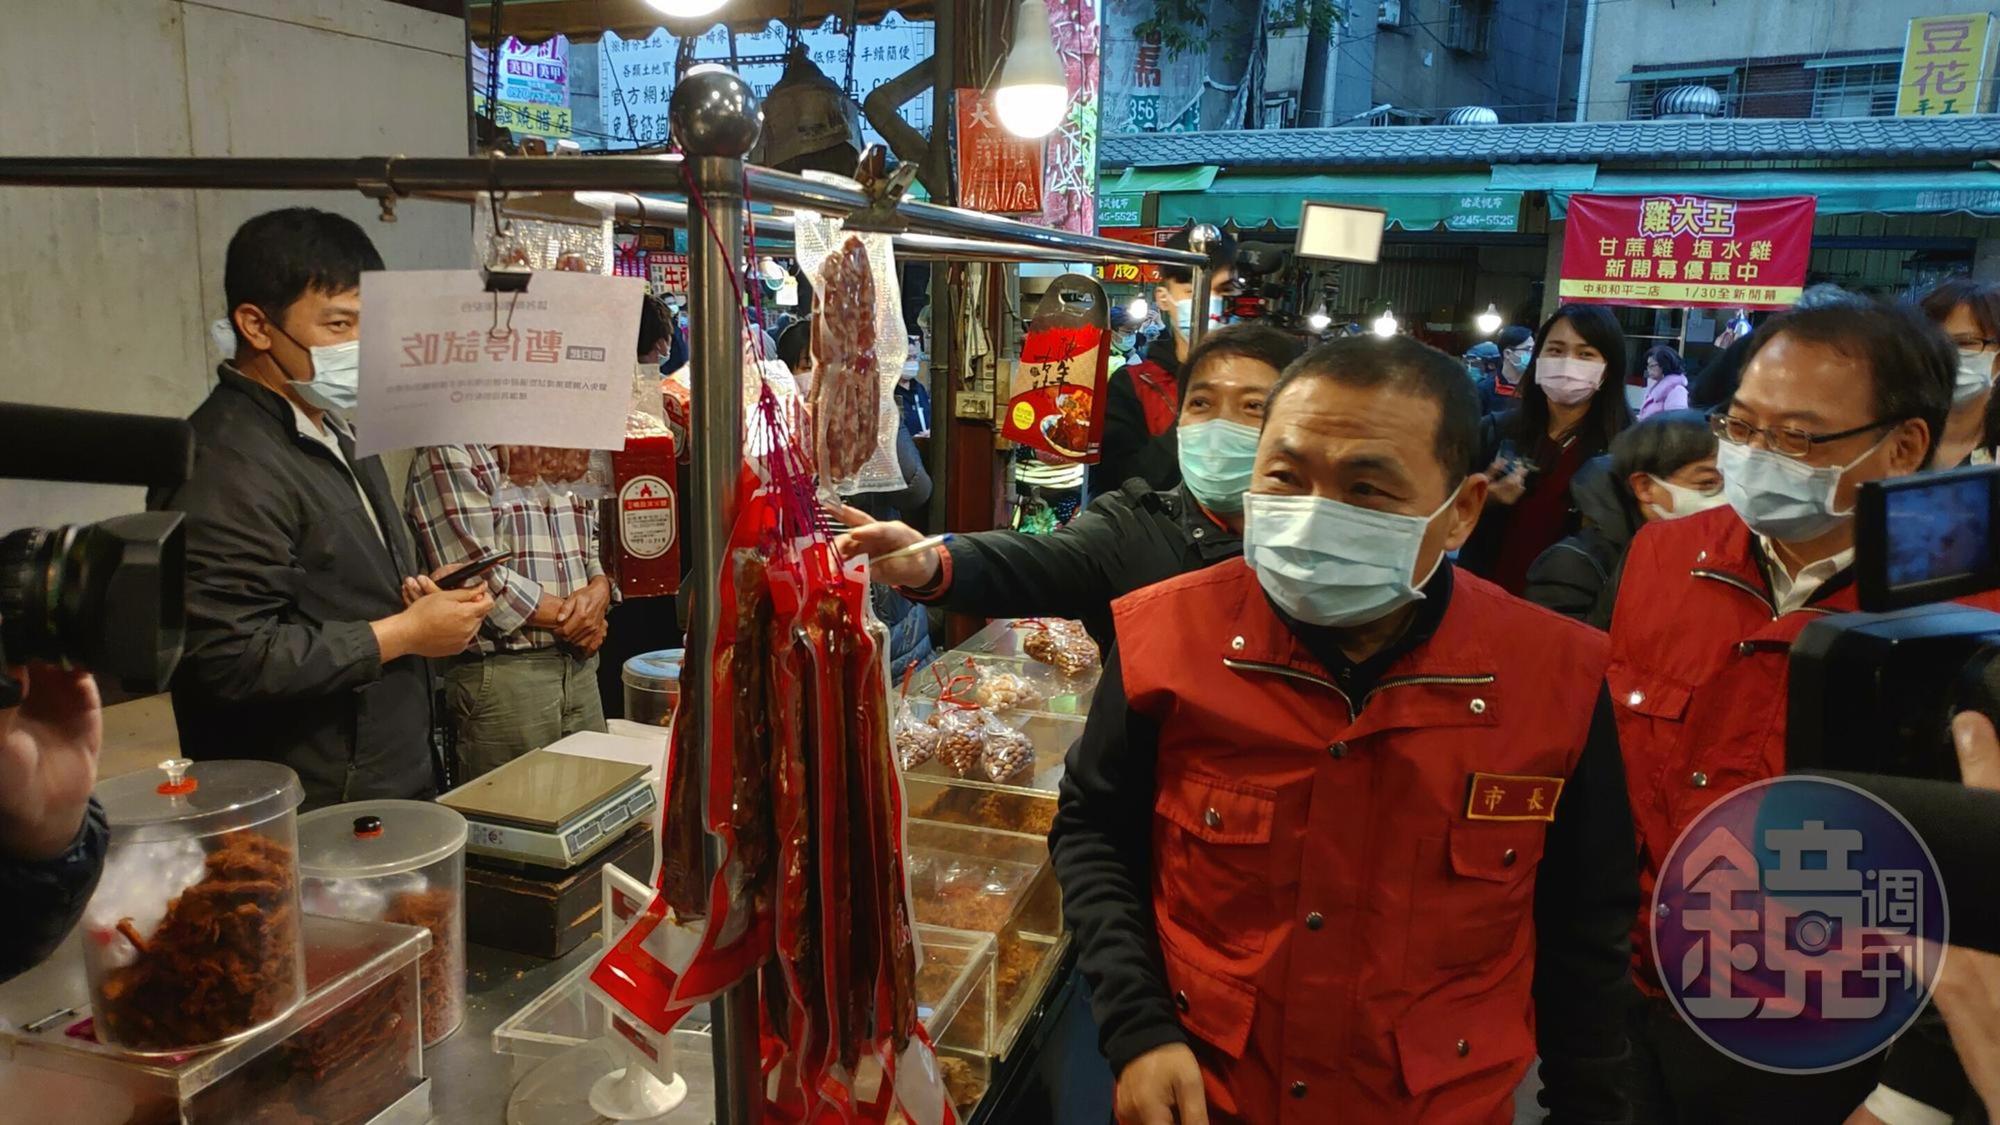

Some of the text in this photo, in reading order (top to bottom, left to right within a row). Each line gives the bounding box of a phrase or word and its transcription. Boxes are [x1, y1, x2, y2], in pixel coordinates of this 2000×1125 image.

[1915, 20, 1975, 96] 豆花
[1915, 99, 1959, 115] 手工
[1451, 214, 1514, 225] 2245-5525
[1641, 198, 1736, 237] 雞大王
[1599, 237, 1675, 259] 甘蔗雞
[1604, 259, 1759, 283] 新開幕優惠中
[1583, 284, 1776, 301] 中和和平二店 1/30全新開幕
[1483, 785, 1544, 812] 市長
